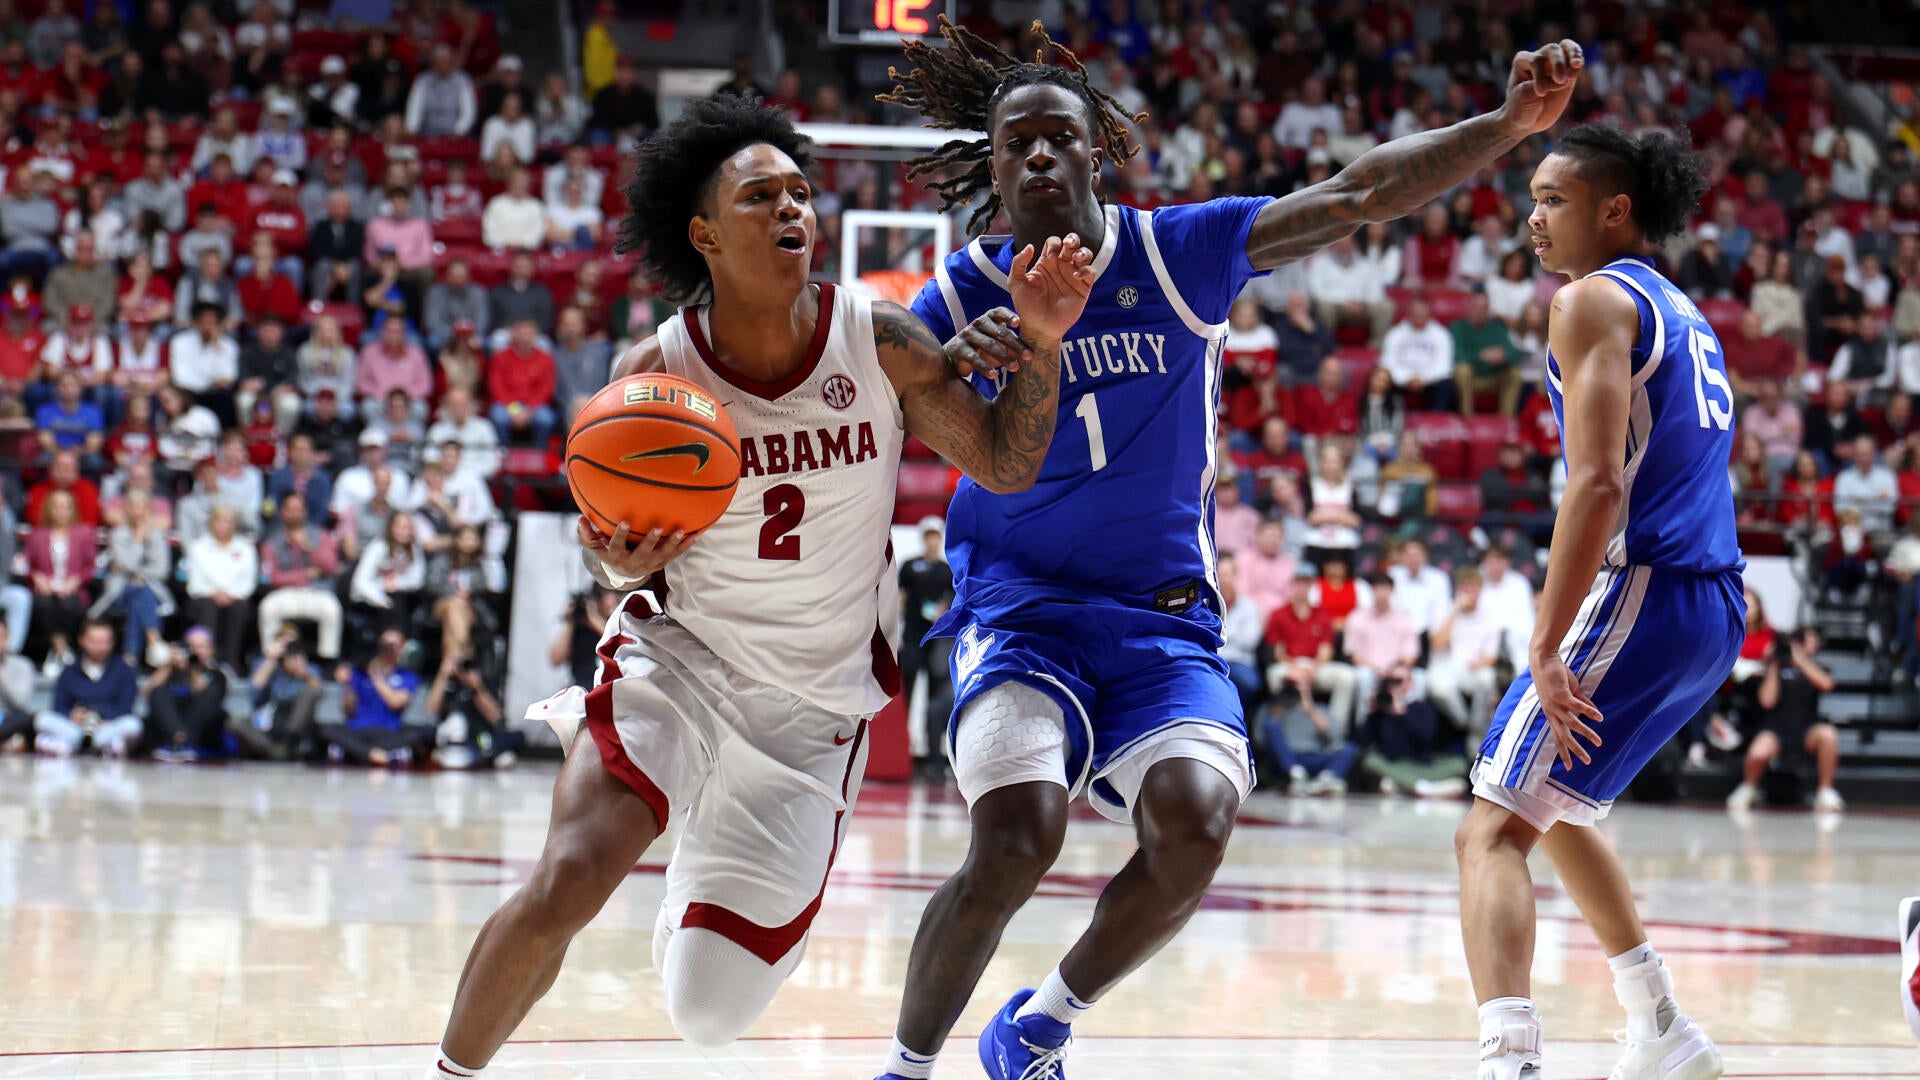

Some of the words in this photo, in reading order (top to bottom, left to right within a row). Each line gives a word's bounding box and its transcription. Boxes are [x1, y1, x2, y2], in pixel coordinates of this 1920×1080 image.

[1118, 286, 1137, 306] SEC
[624, 383, 716, 422] ELITE
[822, 375, 856, 409] SEC
[1688, 326, 1734, 431] 15
[740, 421, 878, 478] ABAMA
[1075, 392, 1107, 472] 1
[758, 483, 806, 561] 2
